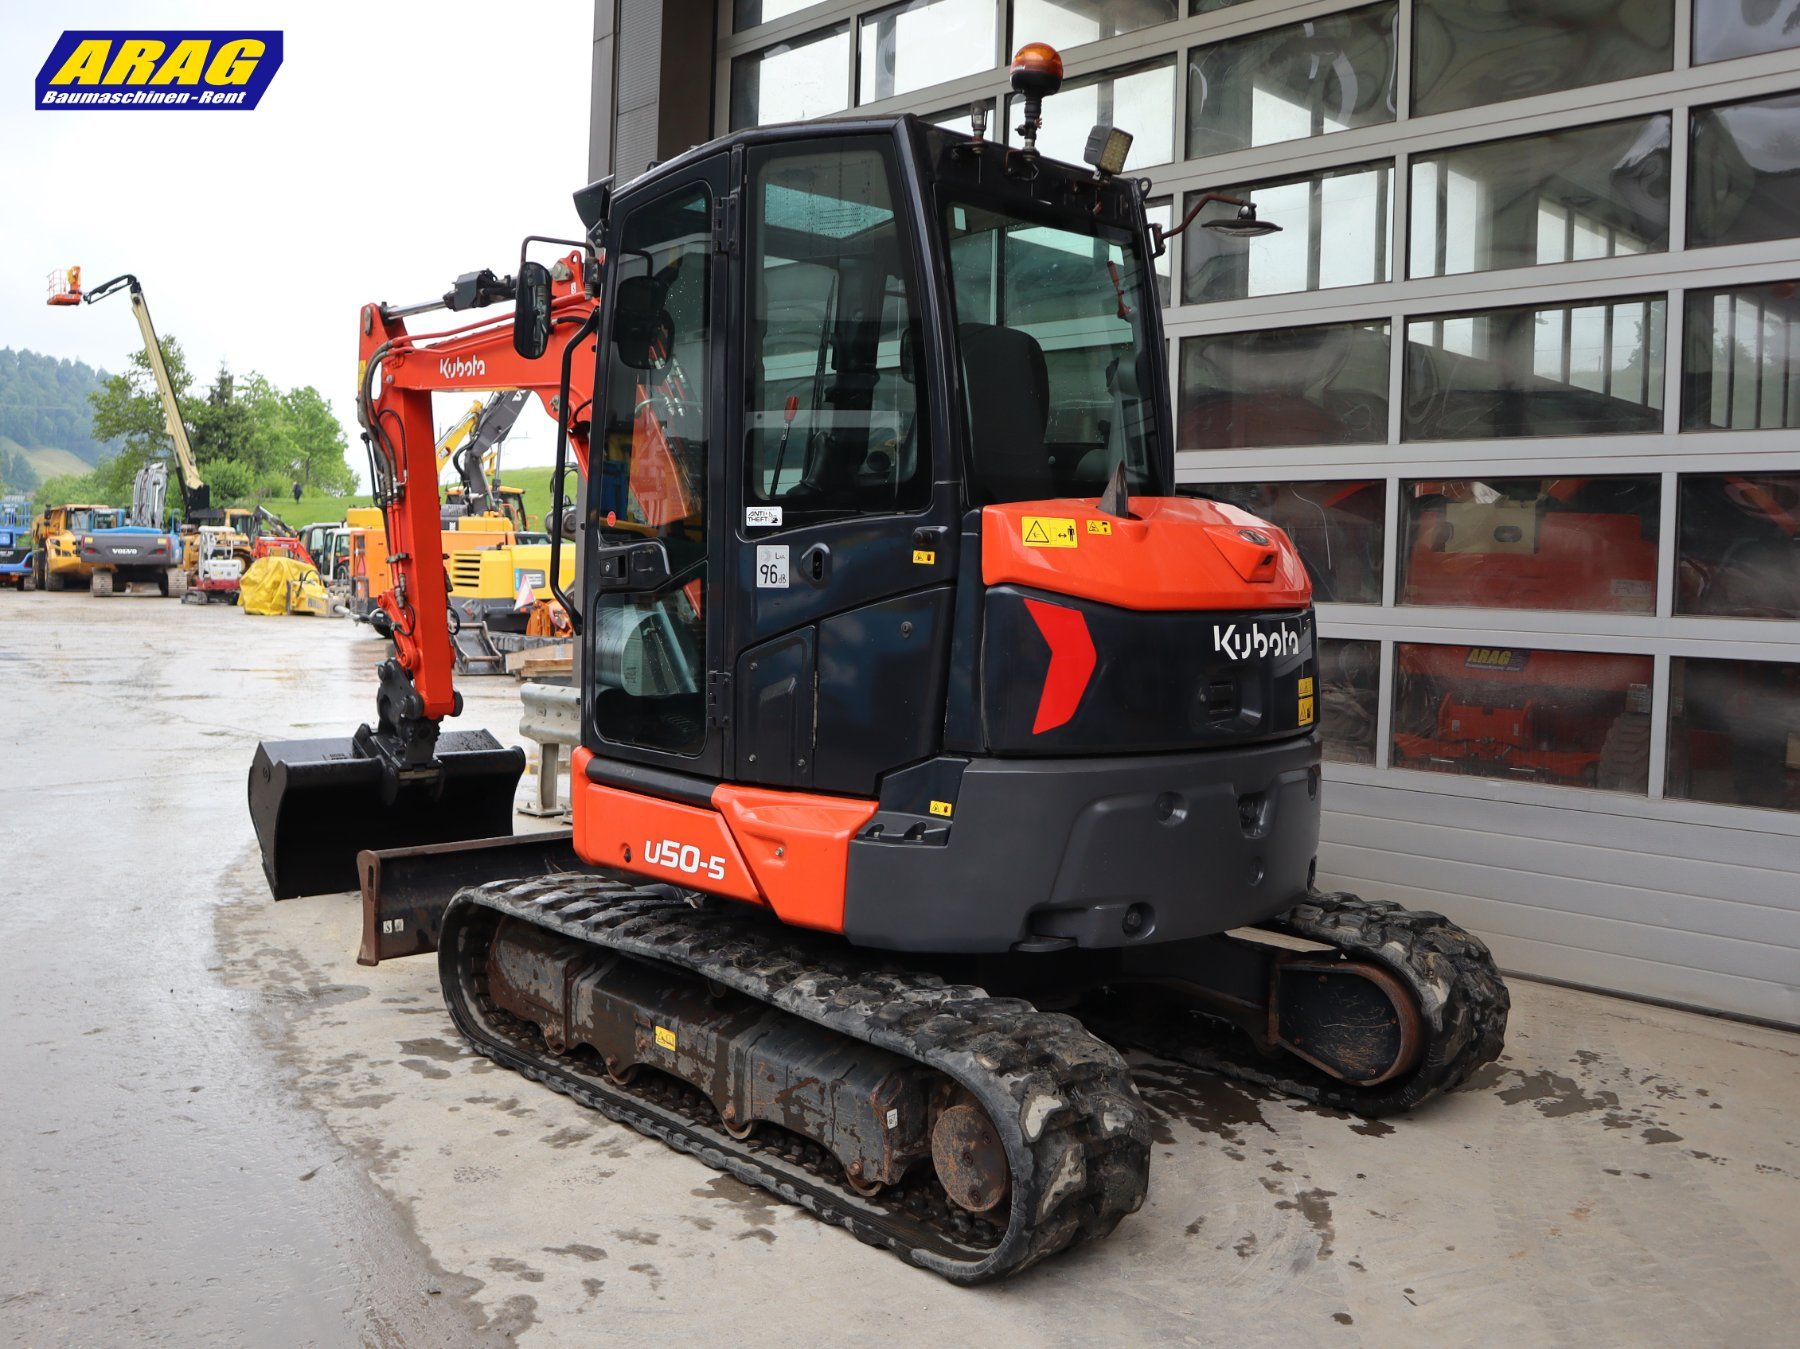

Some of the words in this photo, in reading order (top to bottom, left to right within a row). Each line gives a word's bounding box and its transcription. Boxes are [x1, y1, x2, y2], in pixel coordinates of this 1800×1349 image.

[440, 354, 486, 379] Kubota
[112, 547, 138, 555] VOLVO
[760, 563, 778, 584] 96
[778, 573, 787, 584] dB
[1213, 621, 1299, 660] Kubota
[1467, 648, 1512, 665] ARAG
